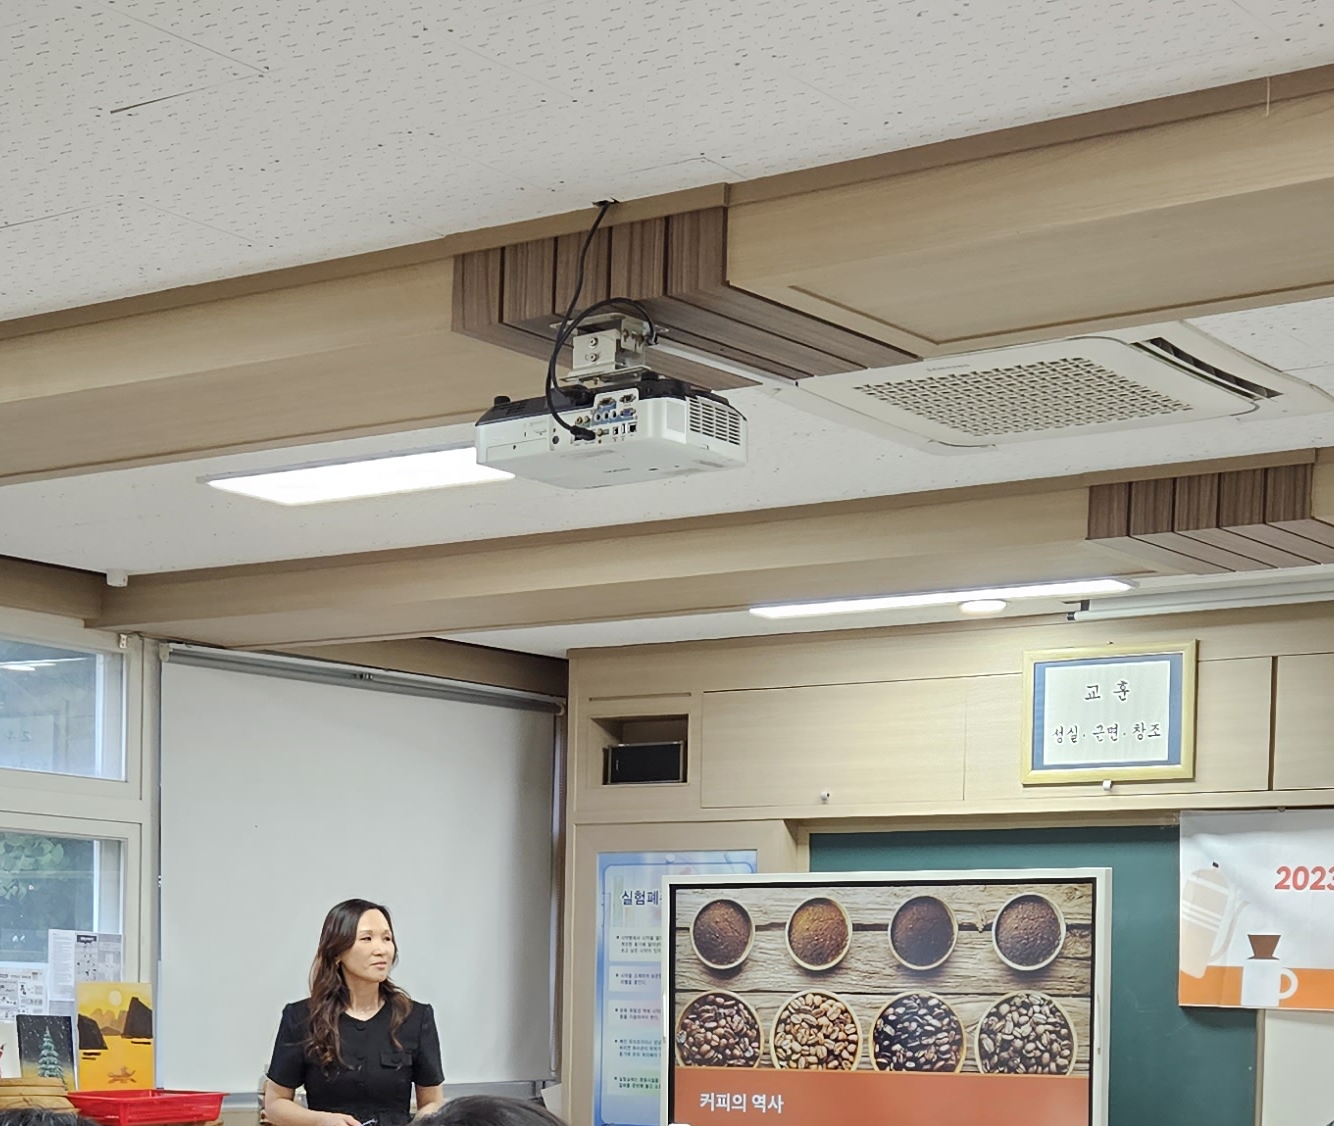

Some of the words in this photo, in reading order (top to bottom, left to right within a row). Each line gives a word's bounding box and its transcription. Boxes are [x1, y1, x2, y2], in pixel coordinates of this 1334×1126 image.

[622, 890, 662, 905] 실험폐
[699, 1092, 747, 1113] 커피의
[751, 1094, 784, 1114] 역사
